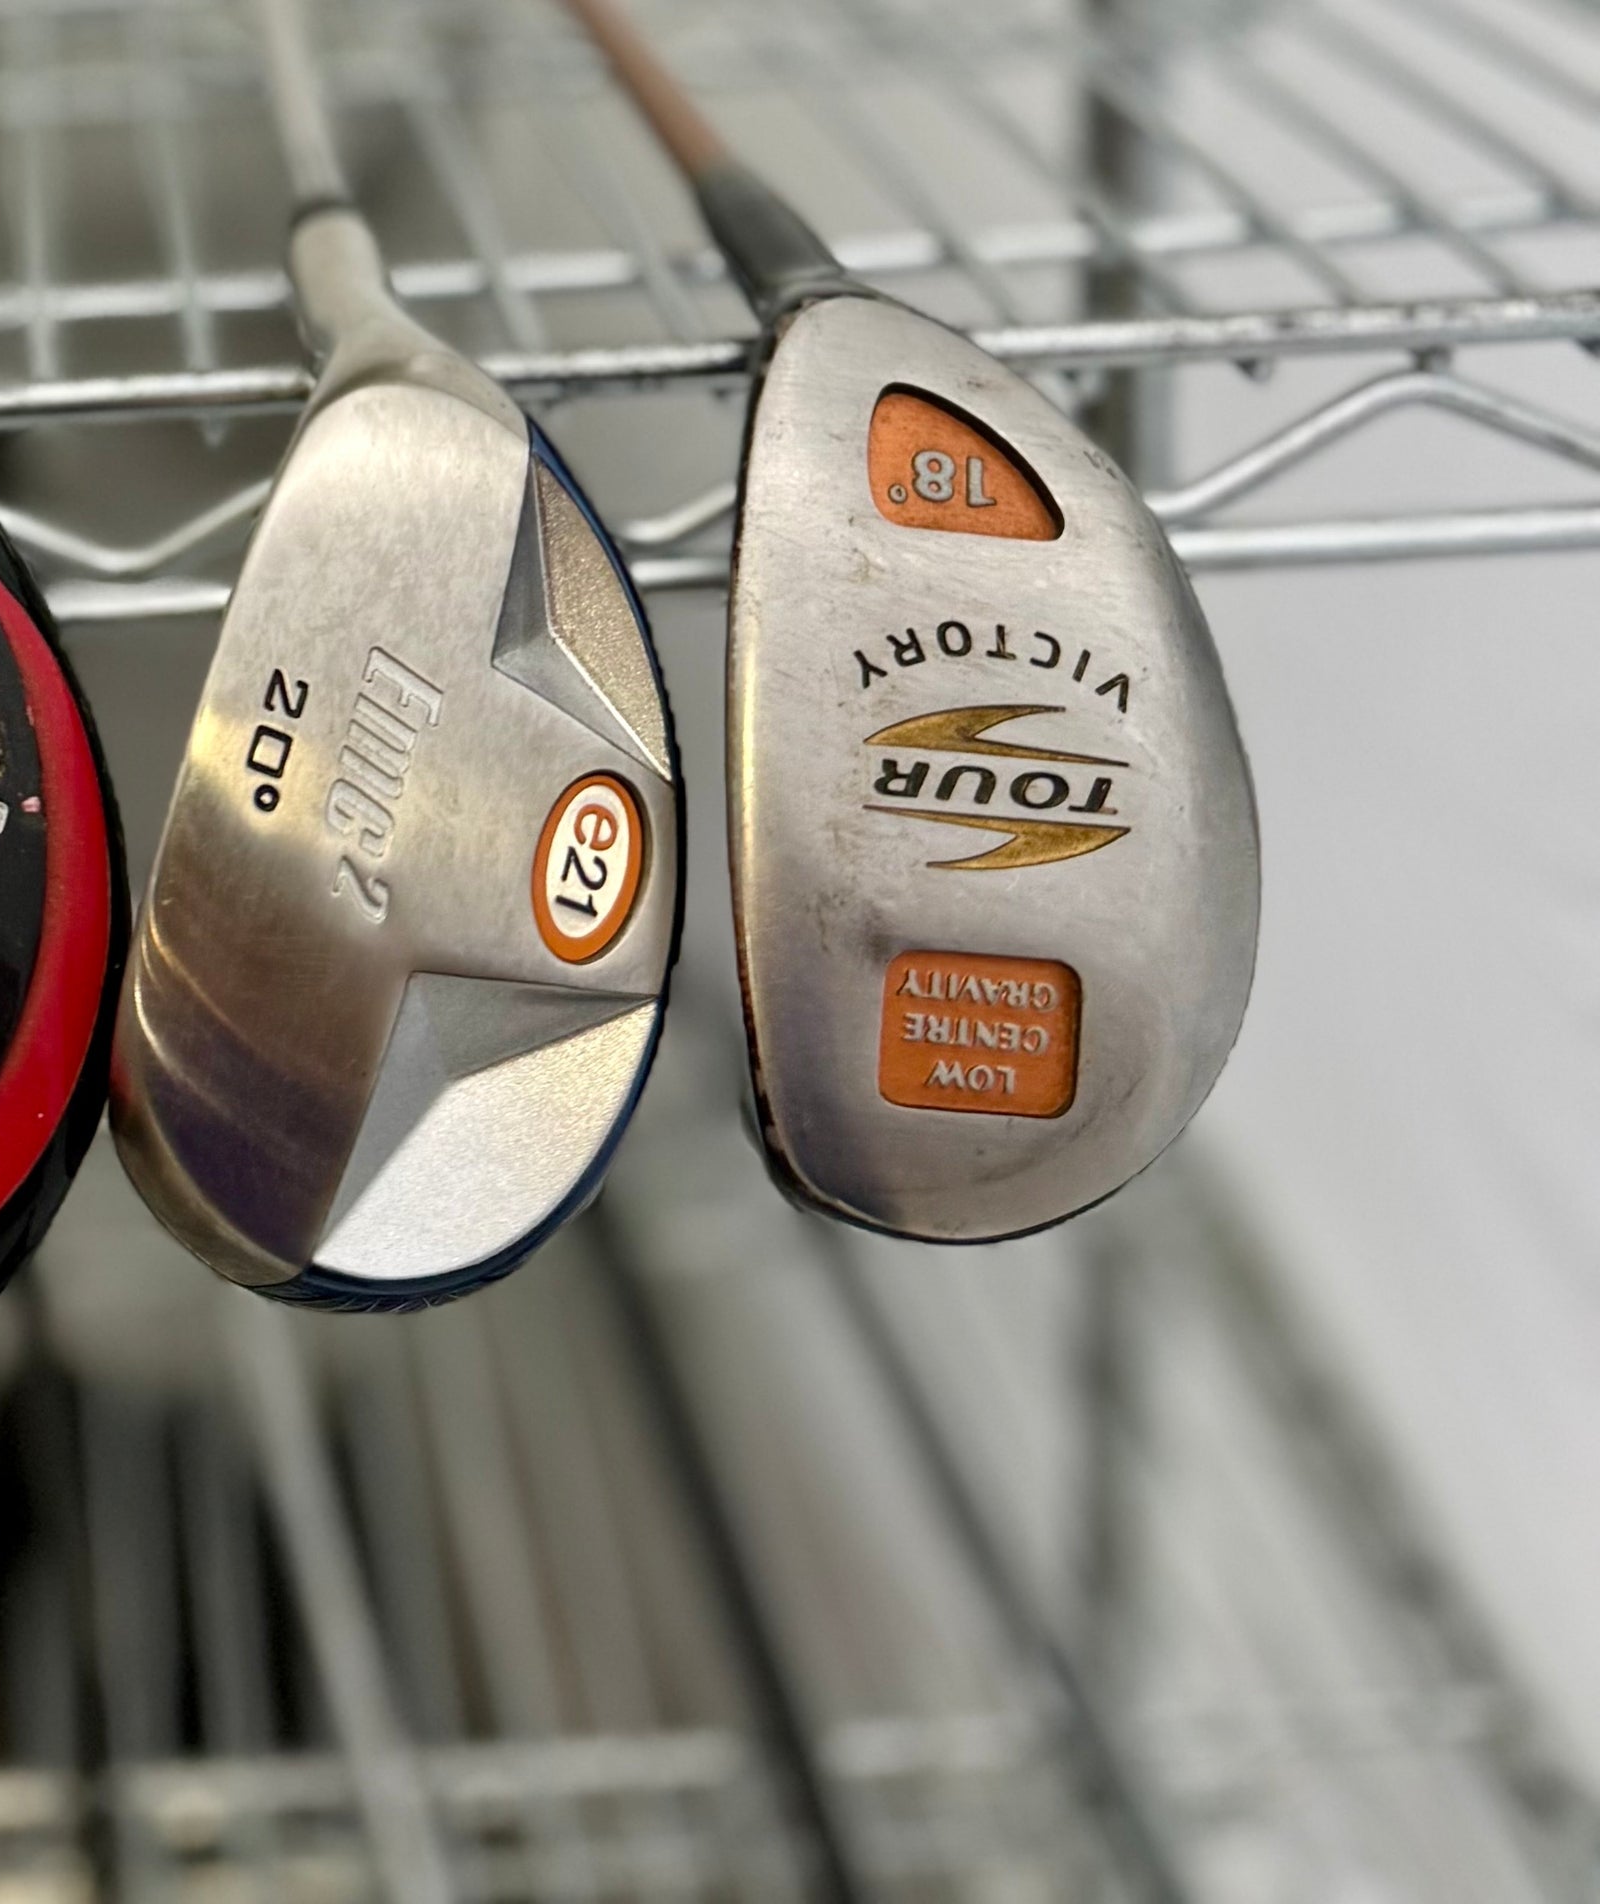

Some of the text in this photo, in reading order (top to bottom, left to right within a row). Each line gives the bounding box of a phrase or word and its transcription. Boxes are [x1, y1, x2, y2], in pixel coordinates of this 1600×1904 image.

[887, 449, 998, 508] 18°
[853, 620, 1131, 714] VICTORY
[246, 668, 309, 813] 20°
[873, 758, 1119, 815] TOUR
[555, 803, 619, 919] e21
[898, 967, 1060, 1010] GRAVITY
[903, 1012, 1050, 1055] CENTRE
[926, 1060, 1018, 1096] LOW
